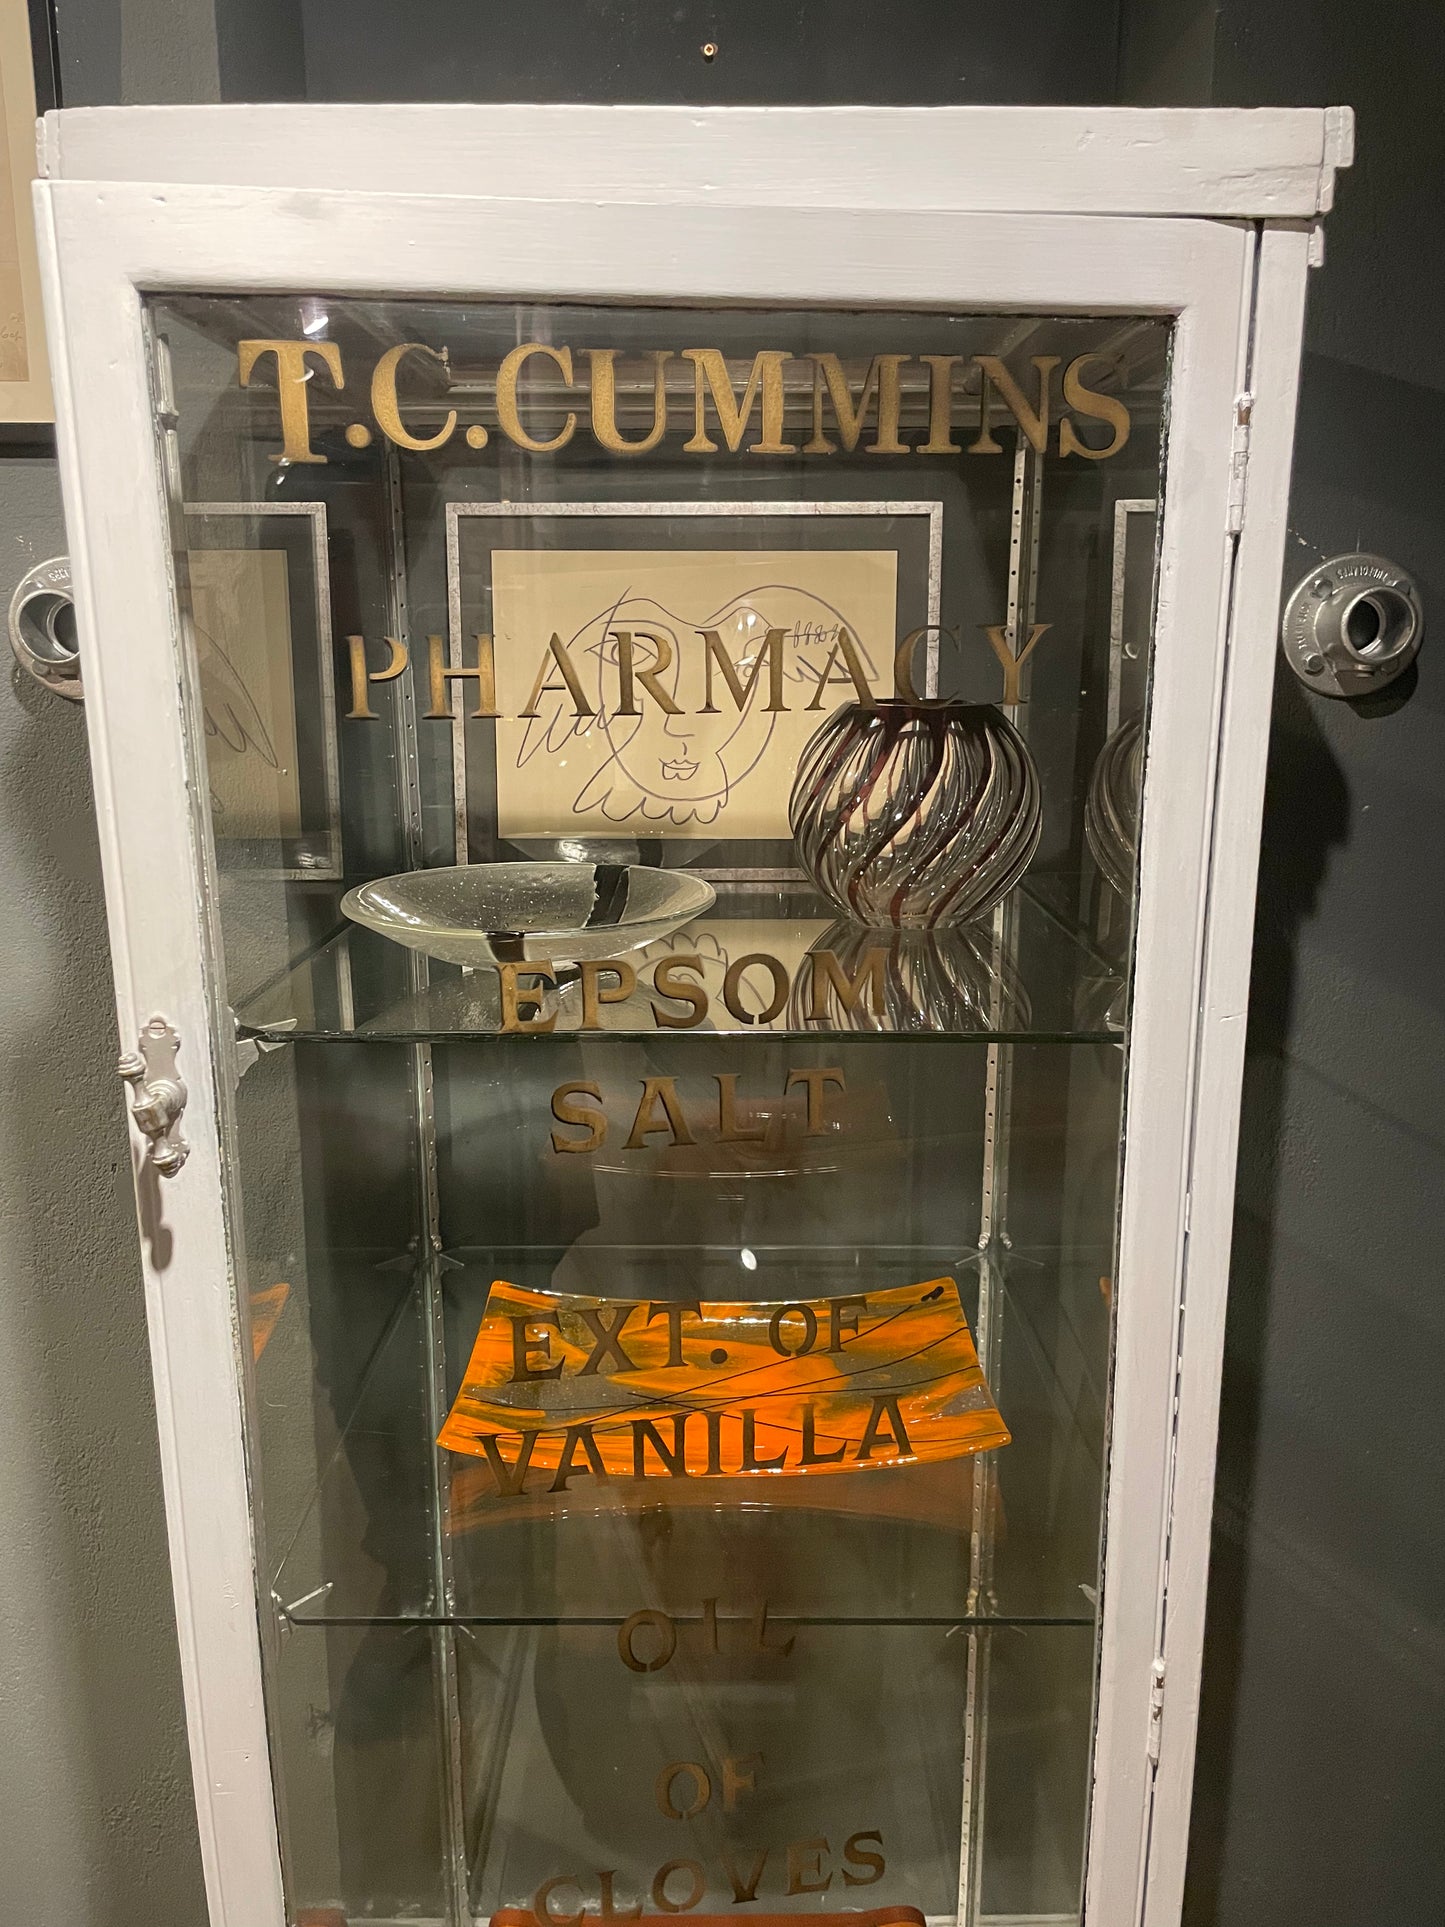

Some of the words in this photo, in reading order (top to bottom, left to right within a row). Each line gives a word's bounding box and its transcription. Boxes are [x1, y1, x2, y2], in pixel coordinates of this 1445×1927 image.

[344, 623, 1054, 720] PHARMACY
[498, 946, 892, 1033] EPSOM
[550, 1067, 846, 1154] SALT
[506, 1301, 728, 1384] EXT.
[769, 1296, 868, 1357] OF
[475, 1394, 912, 1498] VANILLA
[617, 1597, 796, 1672] OIL
[655, 1752, 767, 1820] OF
[533, 1830, 886, 1927] CLOVES
